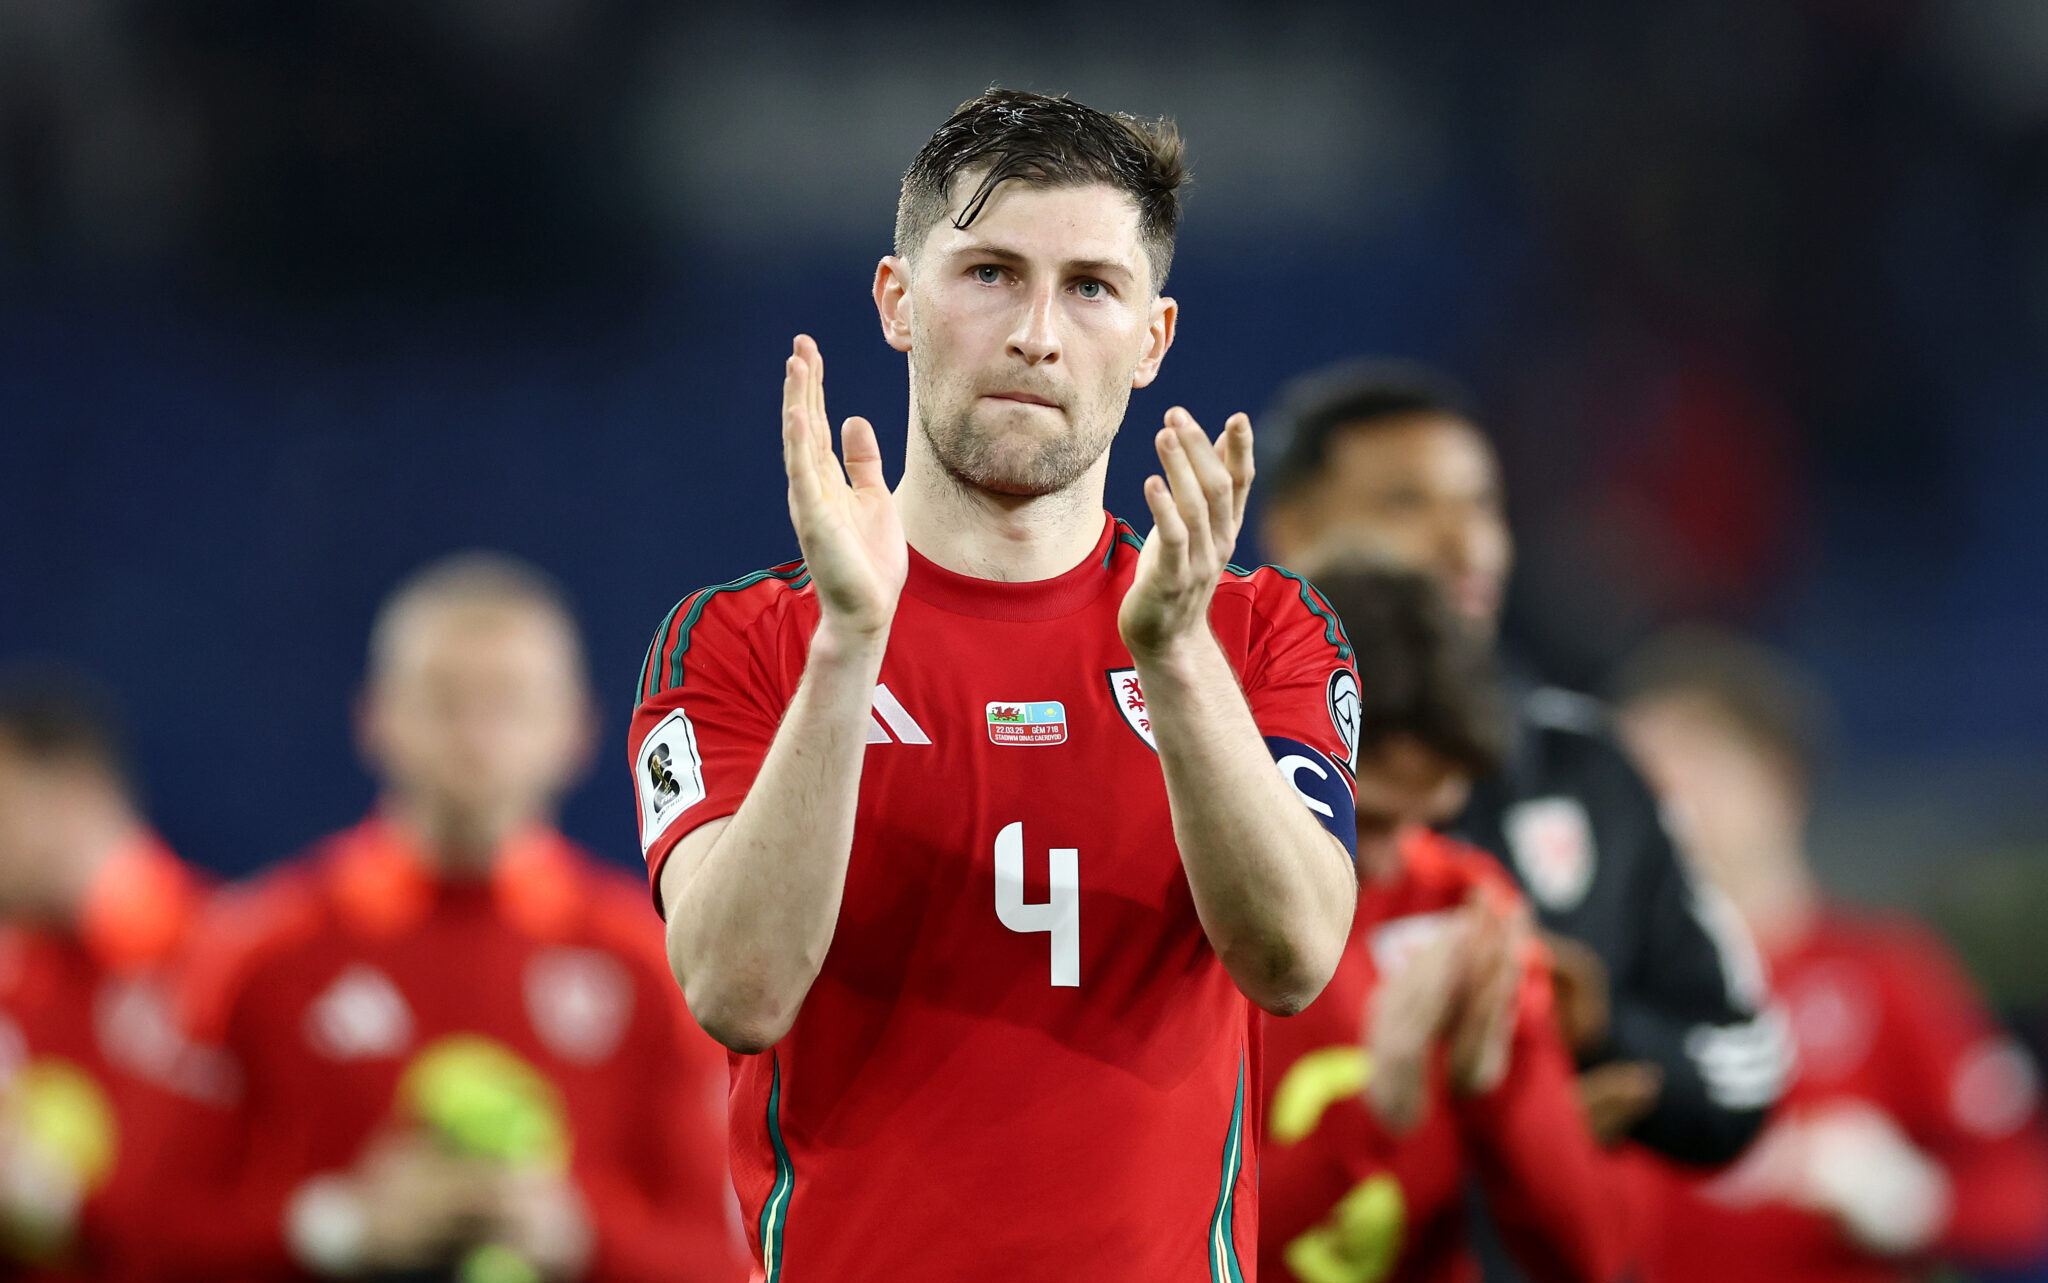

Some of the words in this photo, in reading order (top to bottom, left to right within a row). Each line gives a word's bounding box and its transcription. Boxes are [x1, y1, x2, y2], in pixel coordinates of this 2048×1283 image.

[996, 726, 1024, 734] 22.03.25
[1276, 754, 1334, 818] C
[994, 821, 1080, 987] 4
